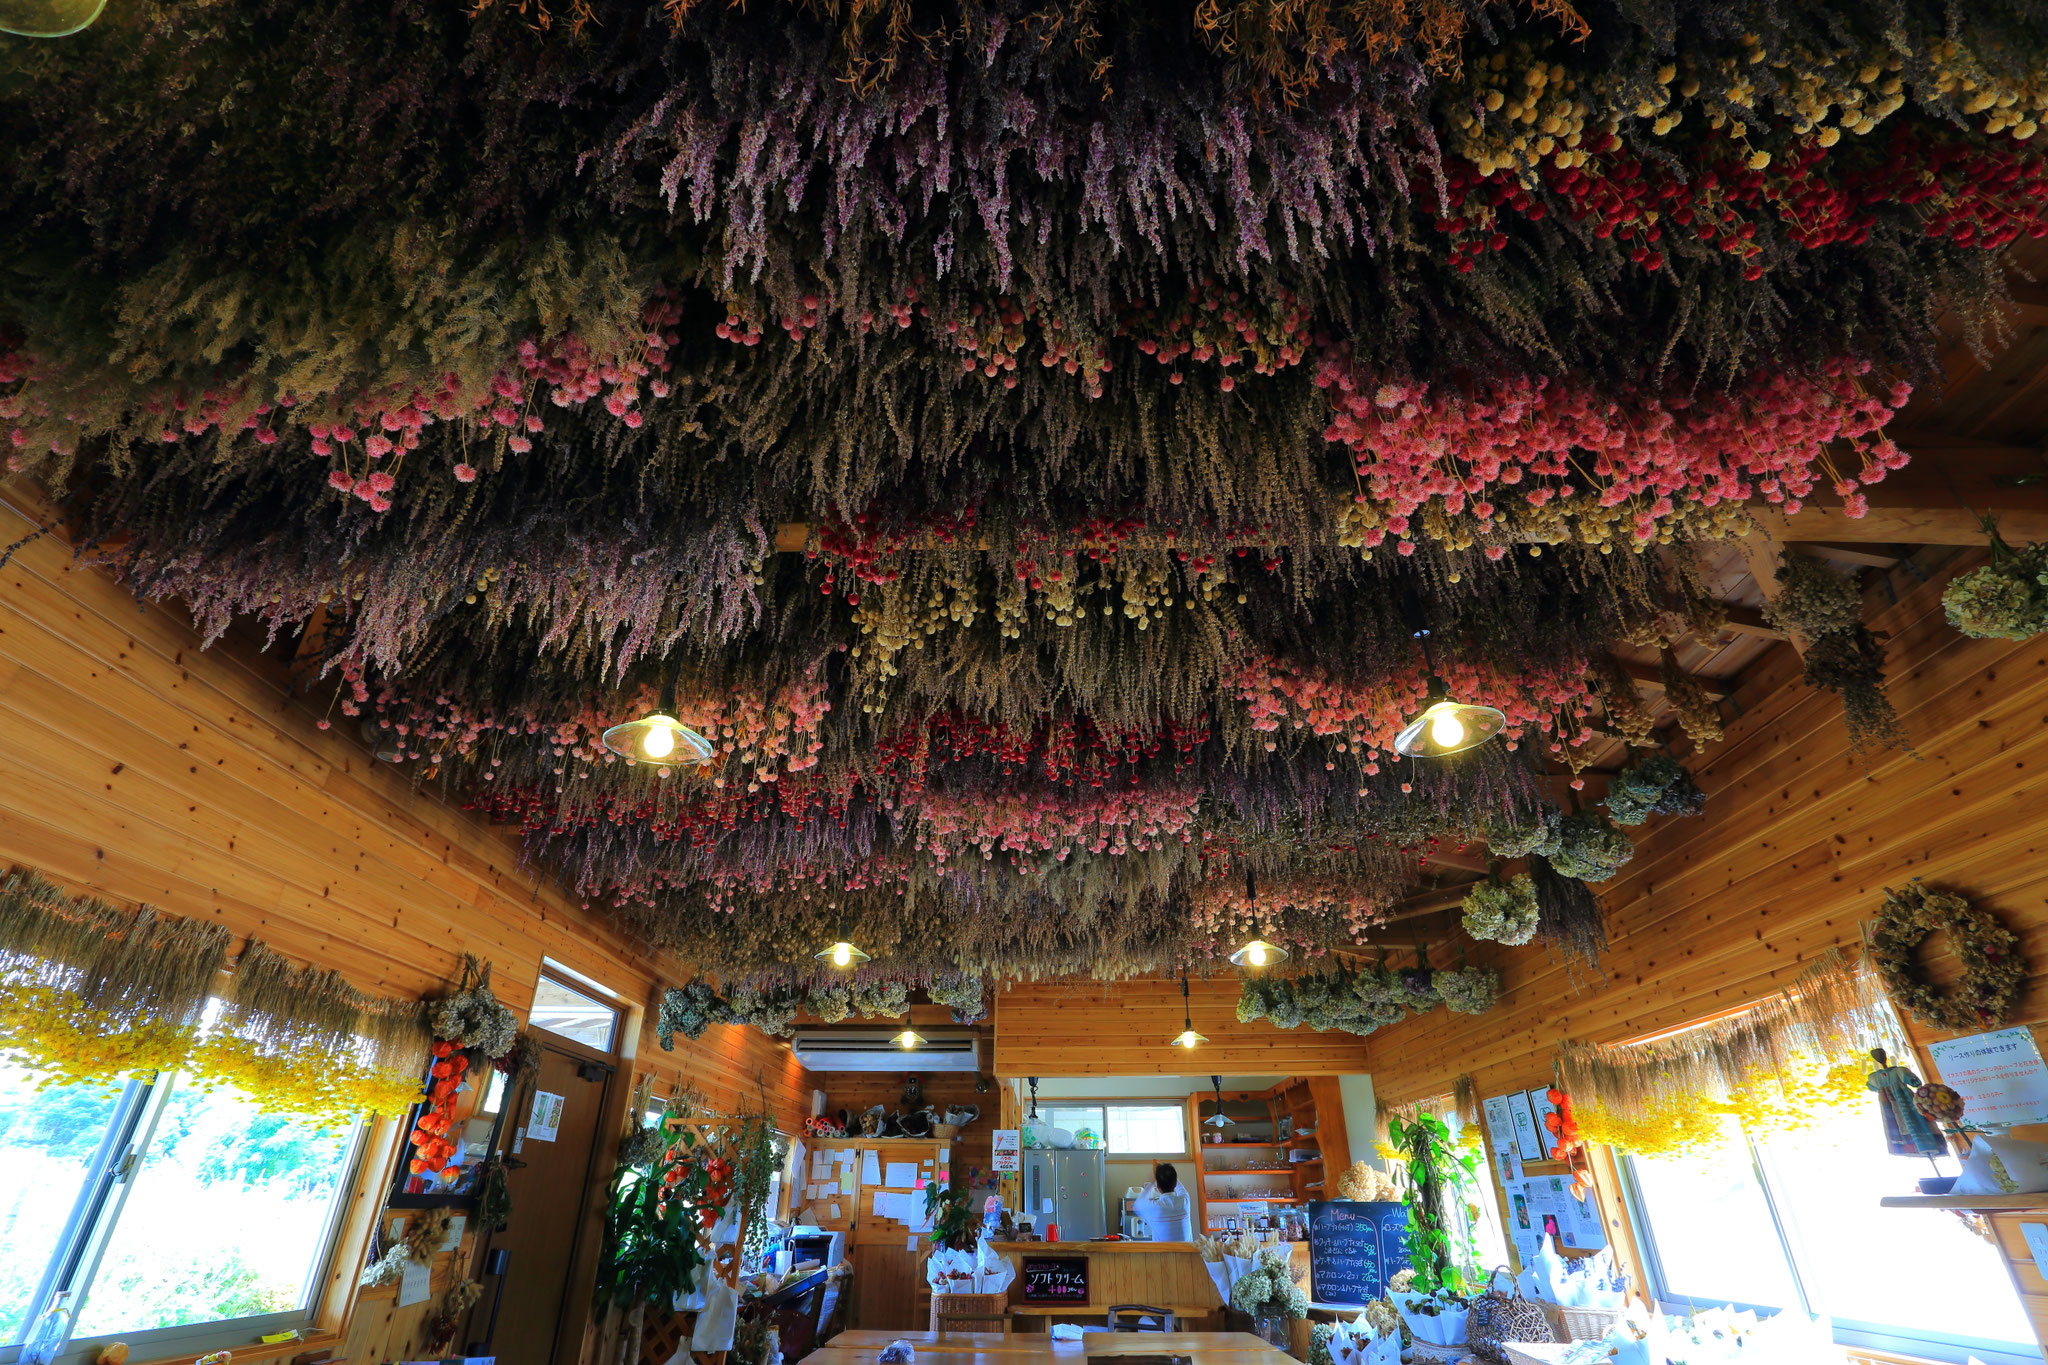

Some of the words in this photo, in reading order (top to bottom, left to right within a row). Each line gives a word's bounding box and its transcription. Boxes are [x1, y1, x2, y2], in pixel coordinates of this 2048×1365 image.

[1330, 1208, 1355, 1221] Menu
[1031, 1272, 1084, 1284] ソフトクリーム
[1047, 1284, 1067, 1294] 400
